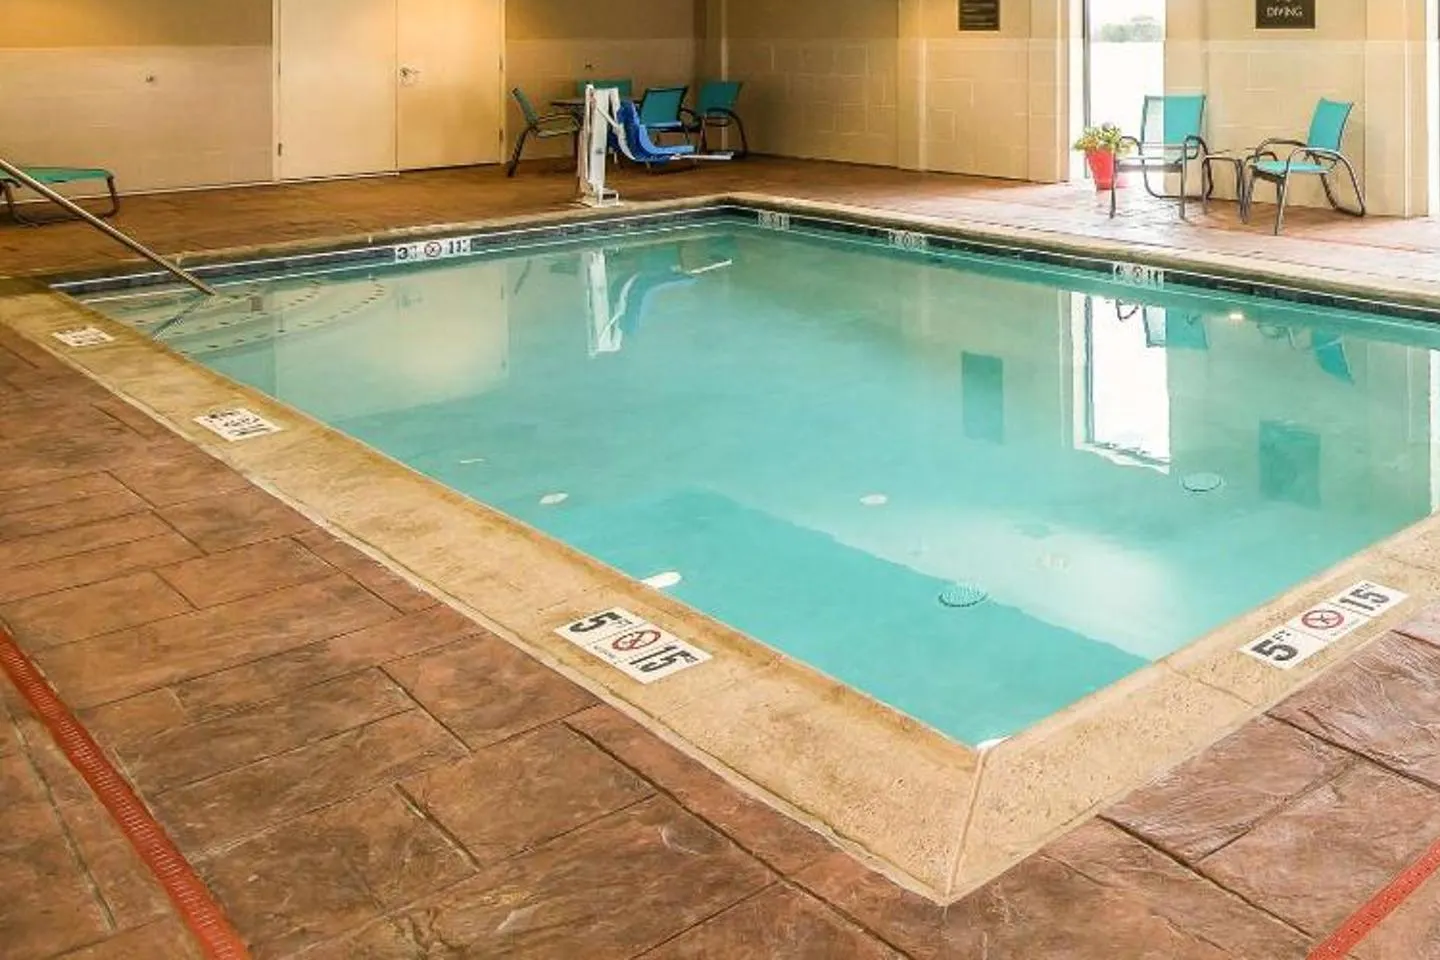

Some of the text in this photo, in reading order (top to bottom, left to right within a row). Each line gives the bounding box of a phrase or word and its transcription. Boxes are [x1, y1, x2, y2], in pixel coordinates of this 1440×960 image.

[1266, 6, 1303, 17] DIVING
[569, 612, 622, 633] 5
[1250, 638, 1298, 661] 5
